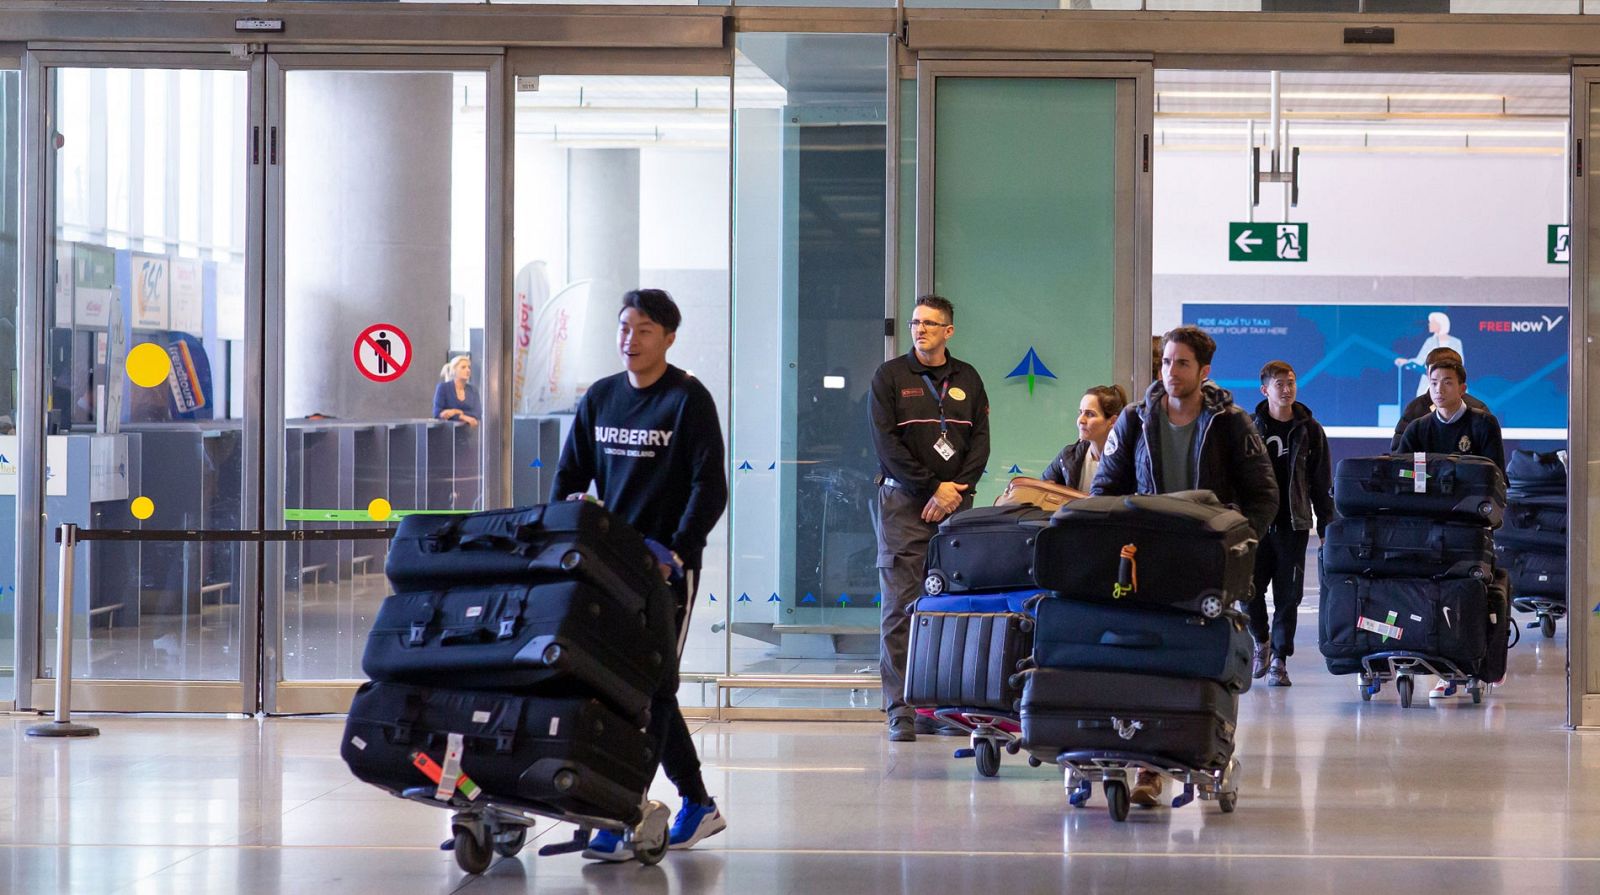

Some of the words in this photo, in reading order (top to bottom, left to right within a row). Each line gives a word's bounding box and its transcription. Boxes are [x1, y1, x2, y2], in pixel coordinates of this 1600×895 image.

[1240, 318, 1251, 326] TU
[1252, 318, 1271, 326] TAXI
[1226, 326, 1248, 335] YOUR
[1249, 326, 1266, 335] TAXI
[1267, 326, 1288, 335] HERE
[169, 346, 195, 407] trendtours
[626, 449, 656, 458] ENGLAND
[291, 530, 305, 540] 13
